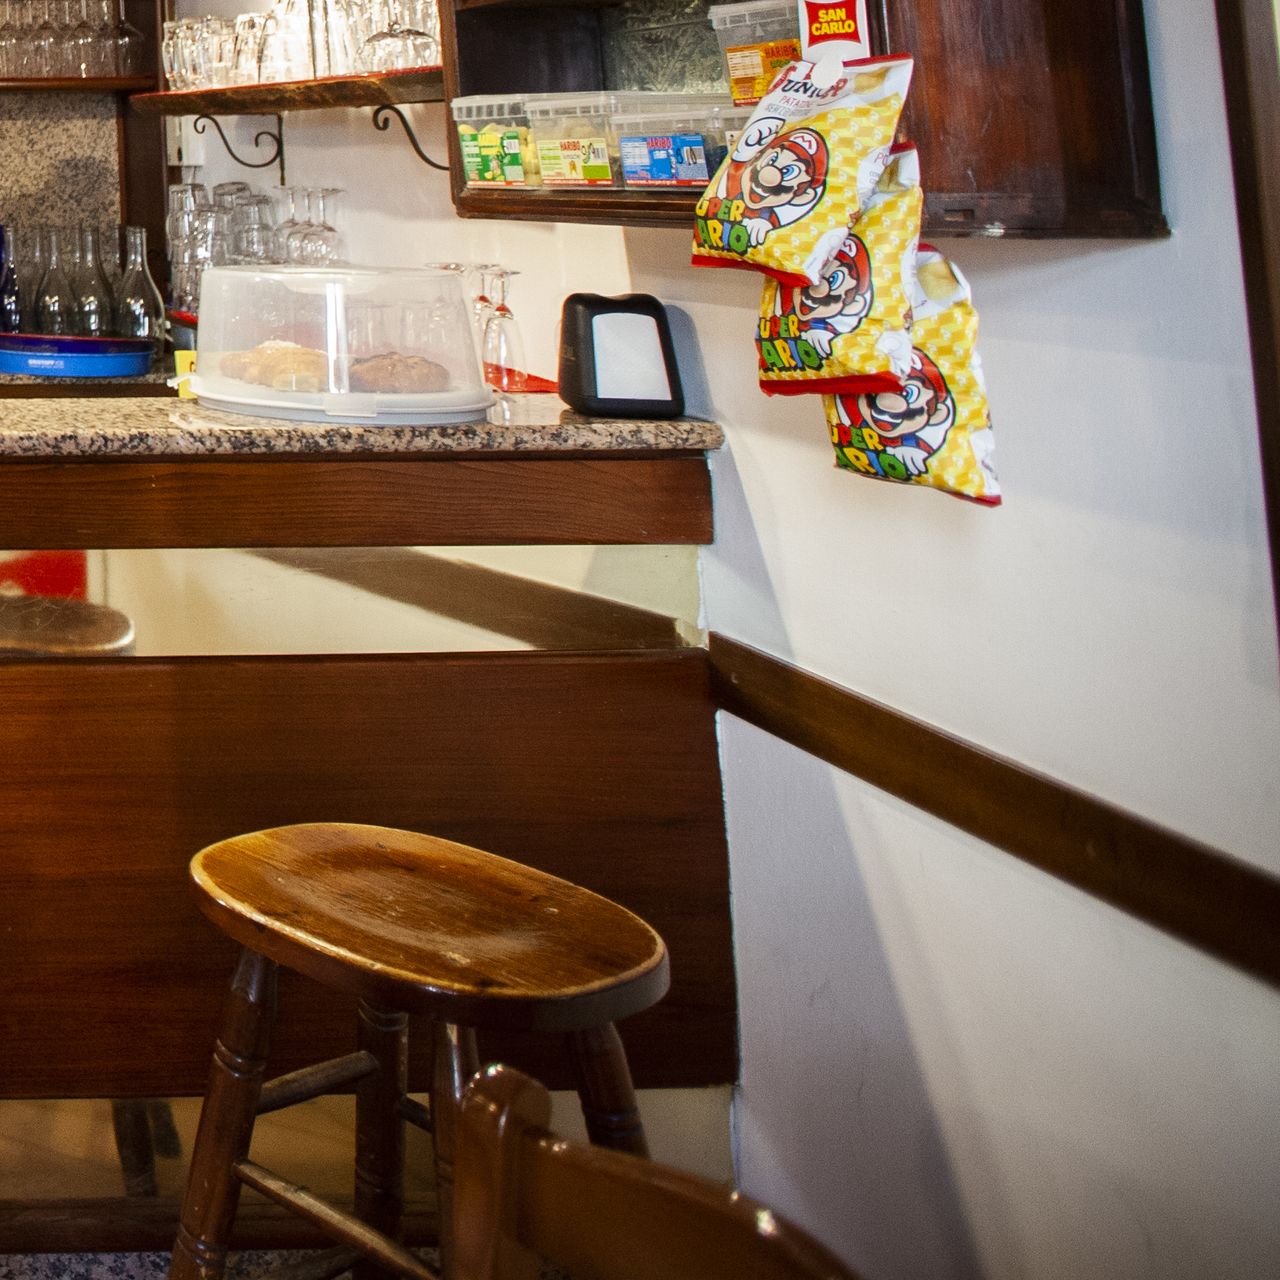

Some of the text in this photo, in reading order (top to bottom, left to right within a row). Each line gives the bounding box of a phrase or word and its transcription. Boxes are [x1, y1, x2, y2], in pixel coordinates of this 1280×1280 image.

[818, 8, 846, 23] SAN
[811, 20, 856, 36] CARLO
[696, 197, 746, 222] UPER
[759, 314, 801, 338] UPER
[831, 424, 884, 451] UPER
[834, 447, 909, 480] RIO
